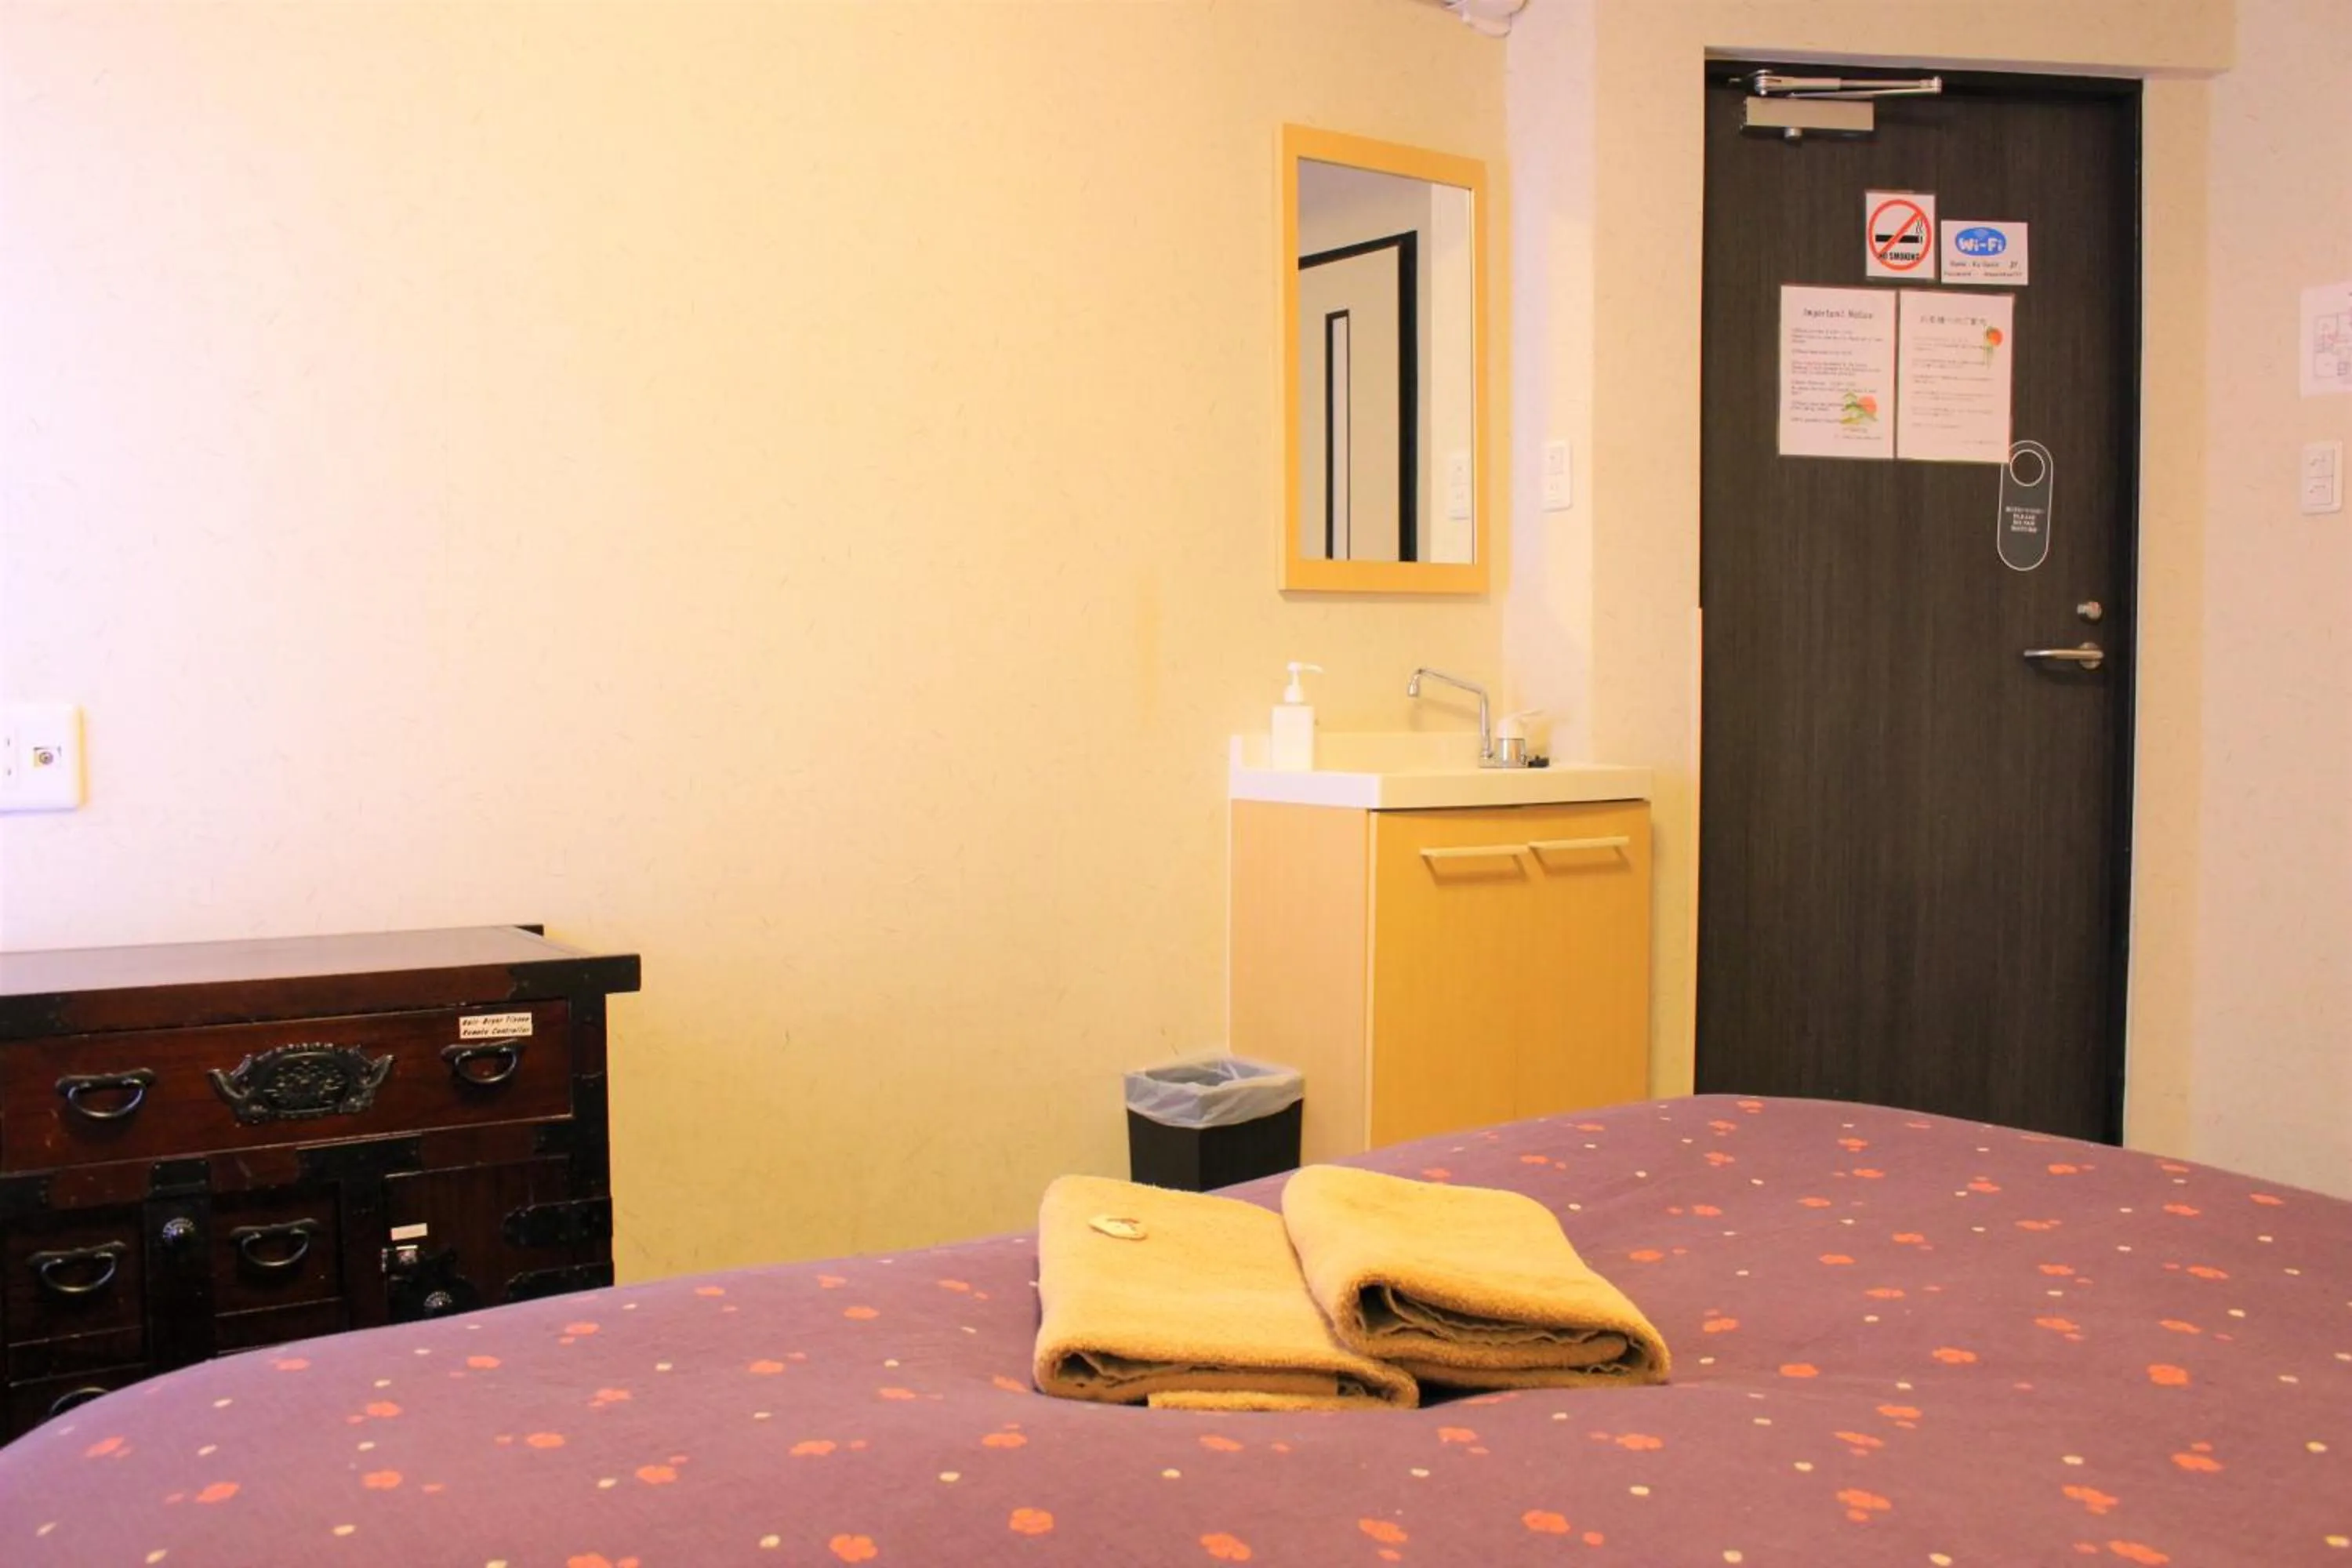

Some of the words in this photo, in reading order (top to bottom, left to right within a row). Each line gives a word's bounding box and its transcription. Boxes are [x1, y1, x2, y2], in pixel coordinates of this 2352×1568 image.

[1958, 237, 2003, 252] Wi-Fi
[1889, 252, 1920, 261] SMOKING
[1803, 307, 1845, 318] Important
[1848, 308, 1873, 320] Notice
